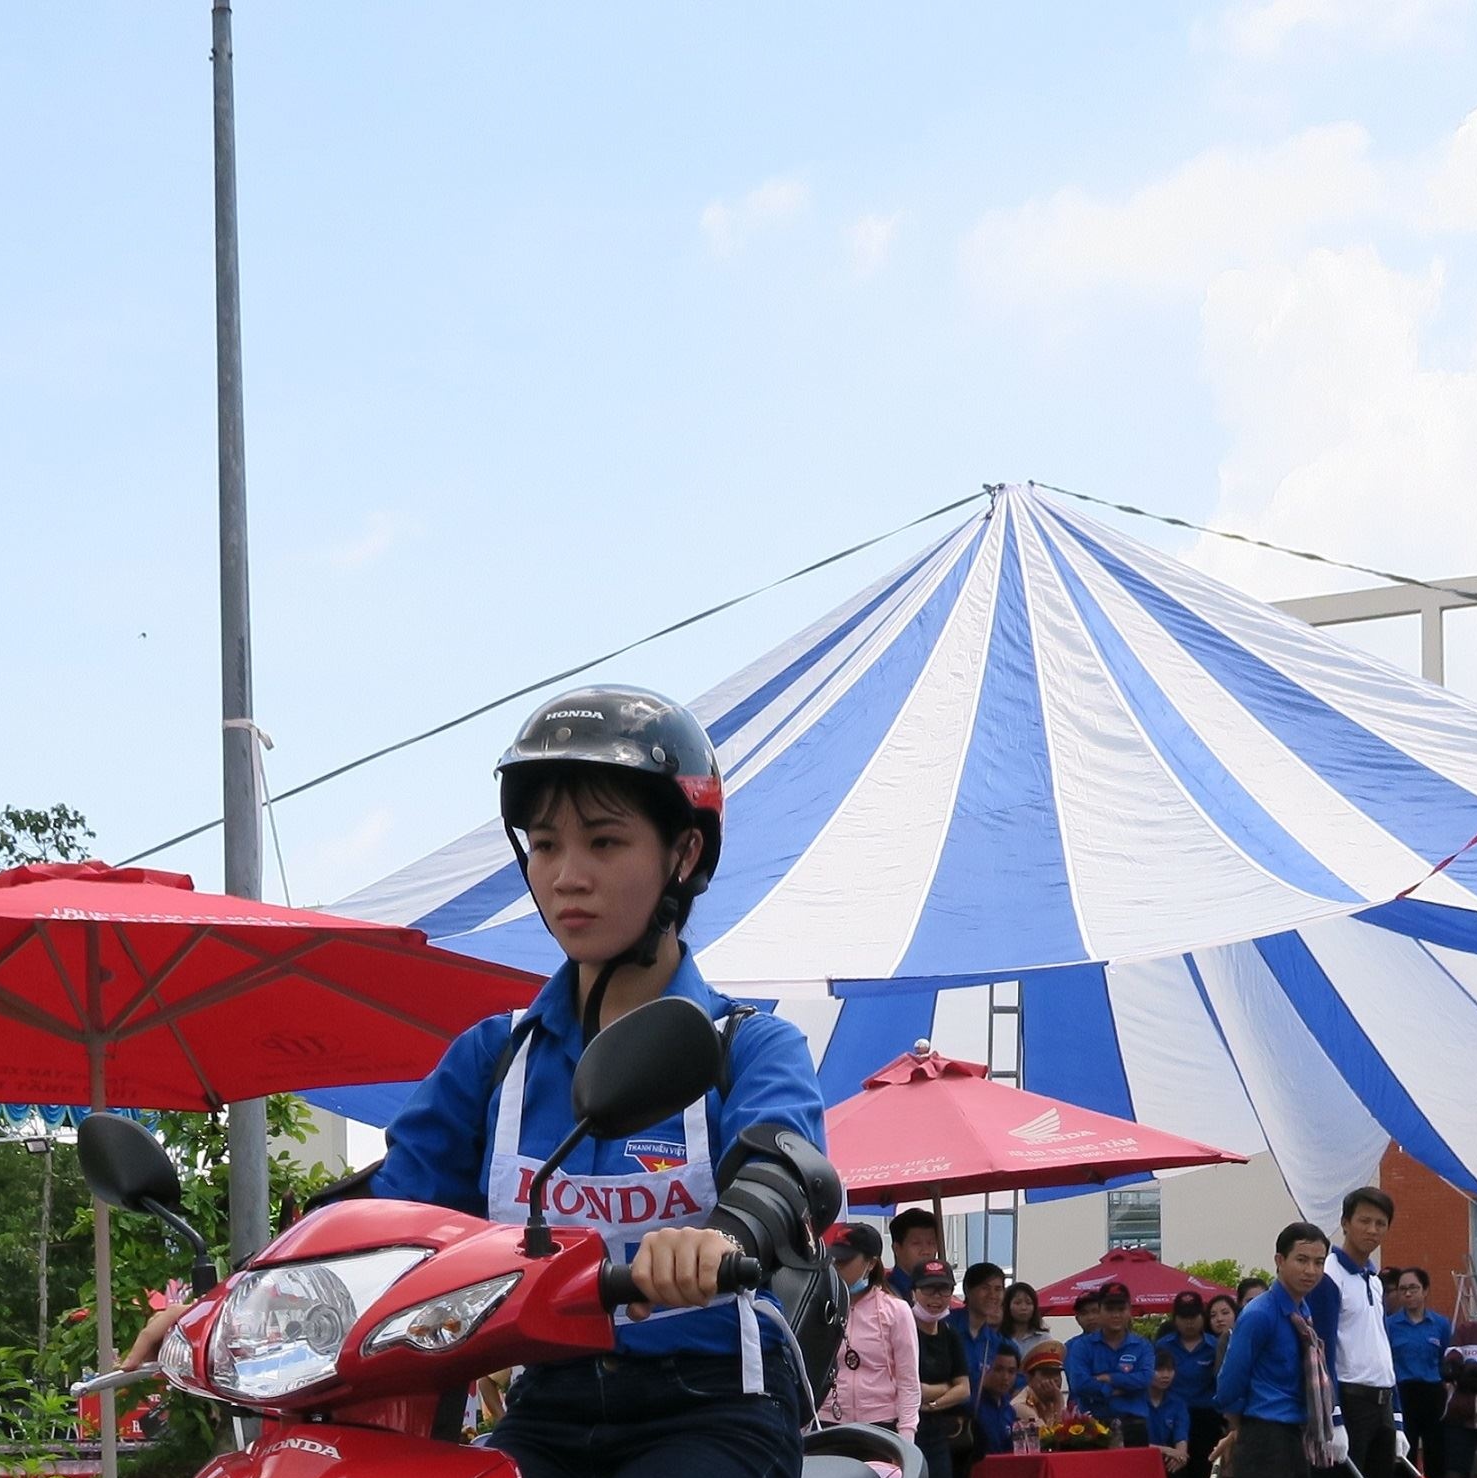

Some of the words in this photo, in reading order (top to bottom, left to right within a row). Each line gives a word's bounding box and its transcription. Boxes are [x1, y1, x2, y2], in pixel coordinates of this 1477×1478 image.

[545, 710, 605, 721] HONDA
[1023, 1130, 1098, 1146] HONDA
[628, 1143, 652, 1152] THANH
[905, 1156, 946, 1167] HEAD
[841, 1171, 891, 1182] UNG
[900, 1162, 953, 1176] TÂM
[514, 1166, 703, 1224] HONDA
